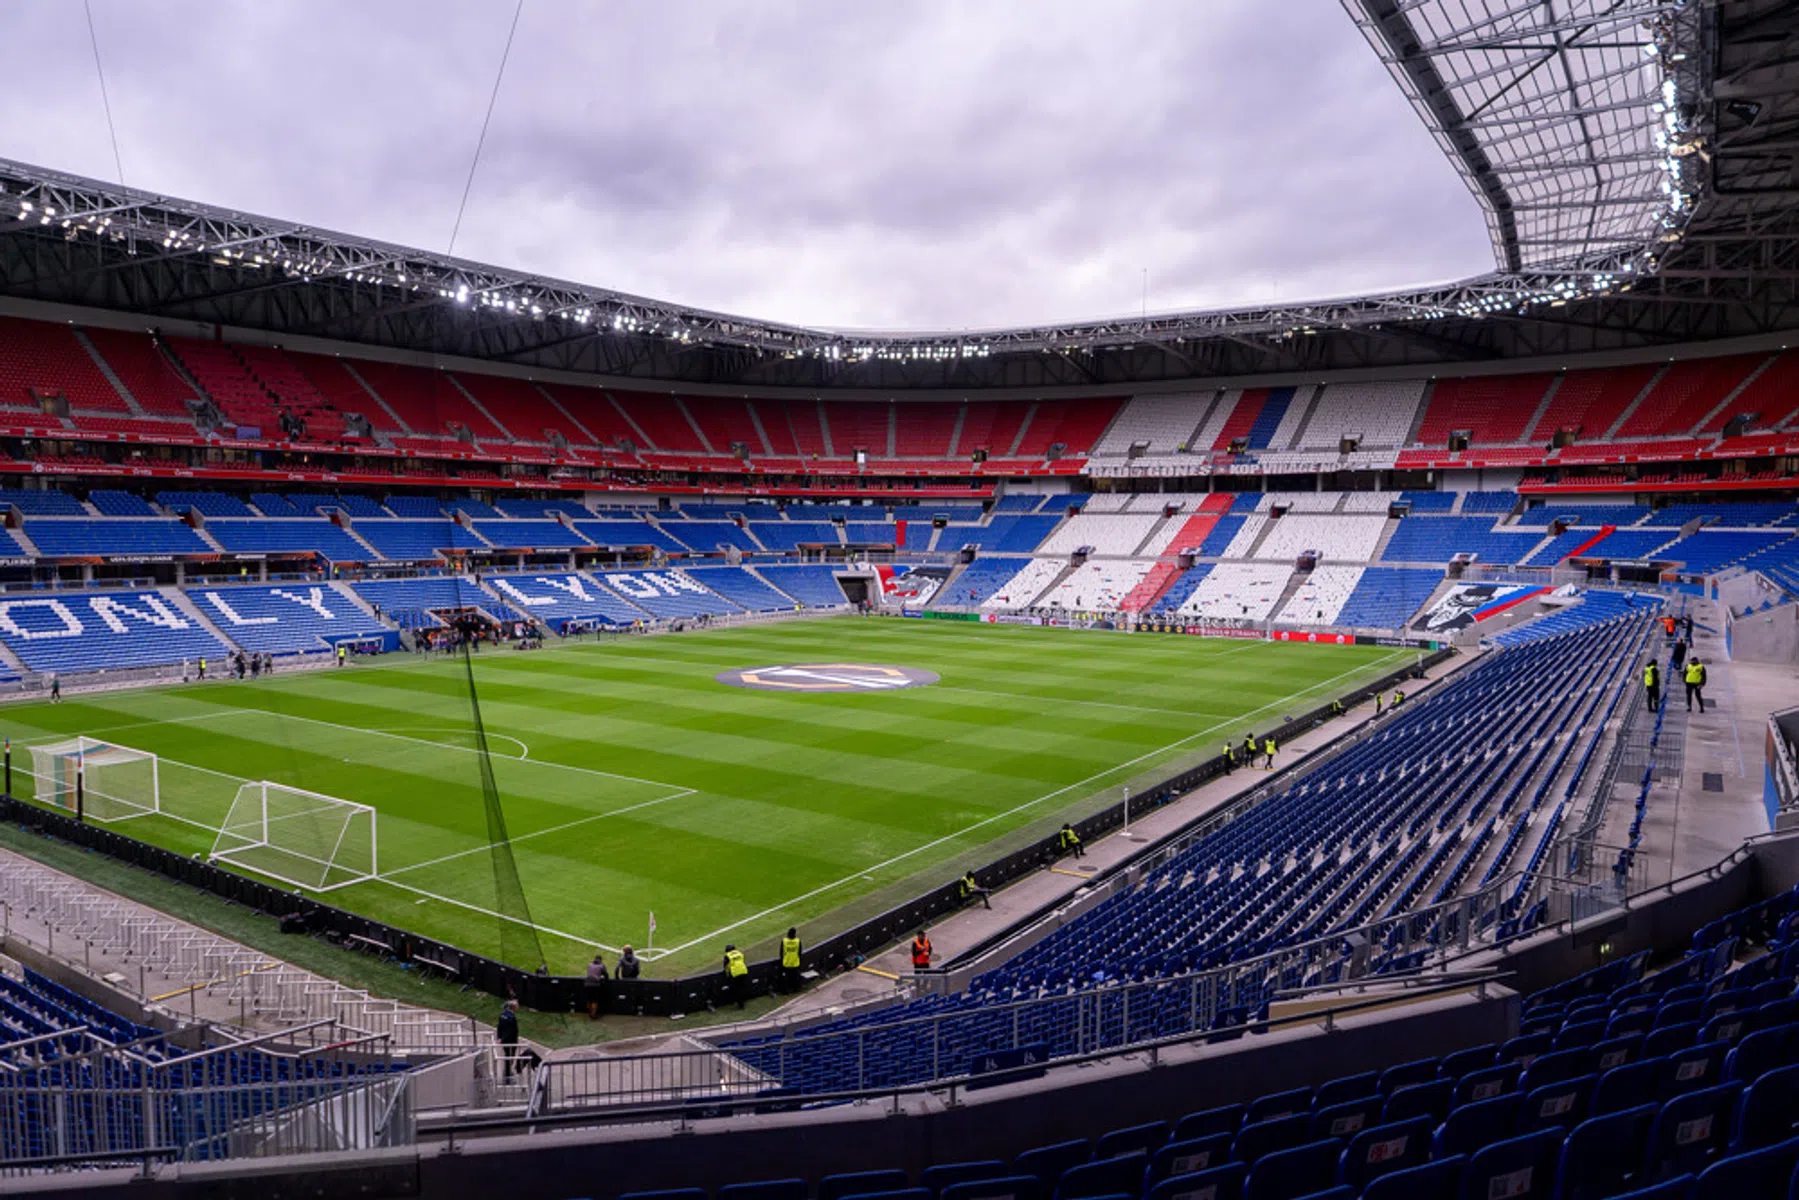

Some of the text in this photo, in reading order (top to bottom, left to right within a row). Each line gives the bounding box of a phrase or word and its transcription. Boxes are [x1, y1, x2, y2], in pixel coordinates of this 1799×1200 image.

[1230, 464, 1260, 475] KOP
[494, 571, 708, 606] LYON
[0, 587, 335, 639] ONLY
